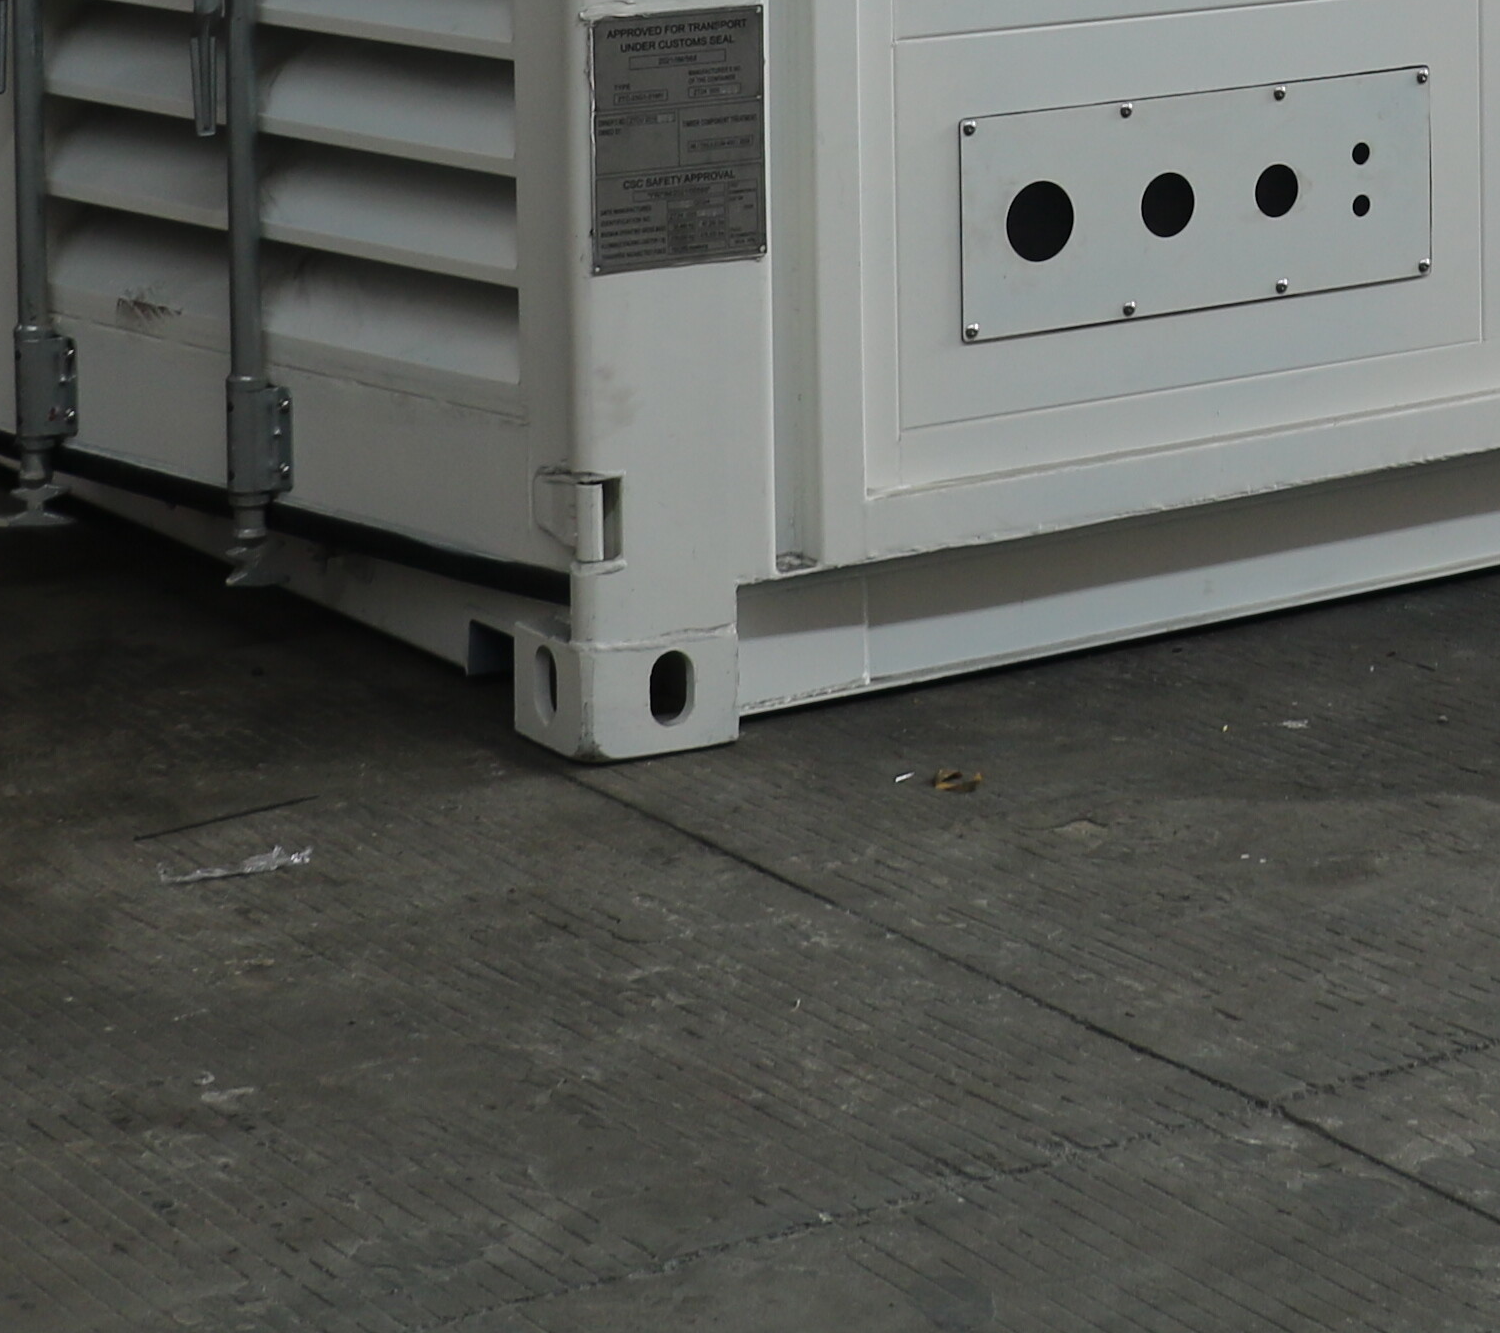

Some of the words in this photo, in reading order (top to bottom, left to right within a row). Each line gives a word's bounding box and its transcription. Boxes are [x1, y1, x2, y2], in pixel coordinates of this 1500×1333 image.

[606, 25, 662, 39] APPROVED
[664, 23, 685, 34] FOR
[688, 18, 747, 32] TRANSPORT
[620, 40, 656, 53] UNDER
[658, 37, 707, 50] CUSTOMS
[709, 34, 735, 46] SEAL
[623, 179, 644, 190] CSC
[645, 174, 682, 187] SAFETY
[684, 170, 736, 183] APPROVAL
